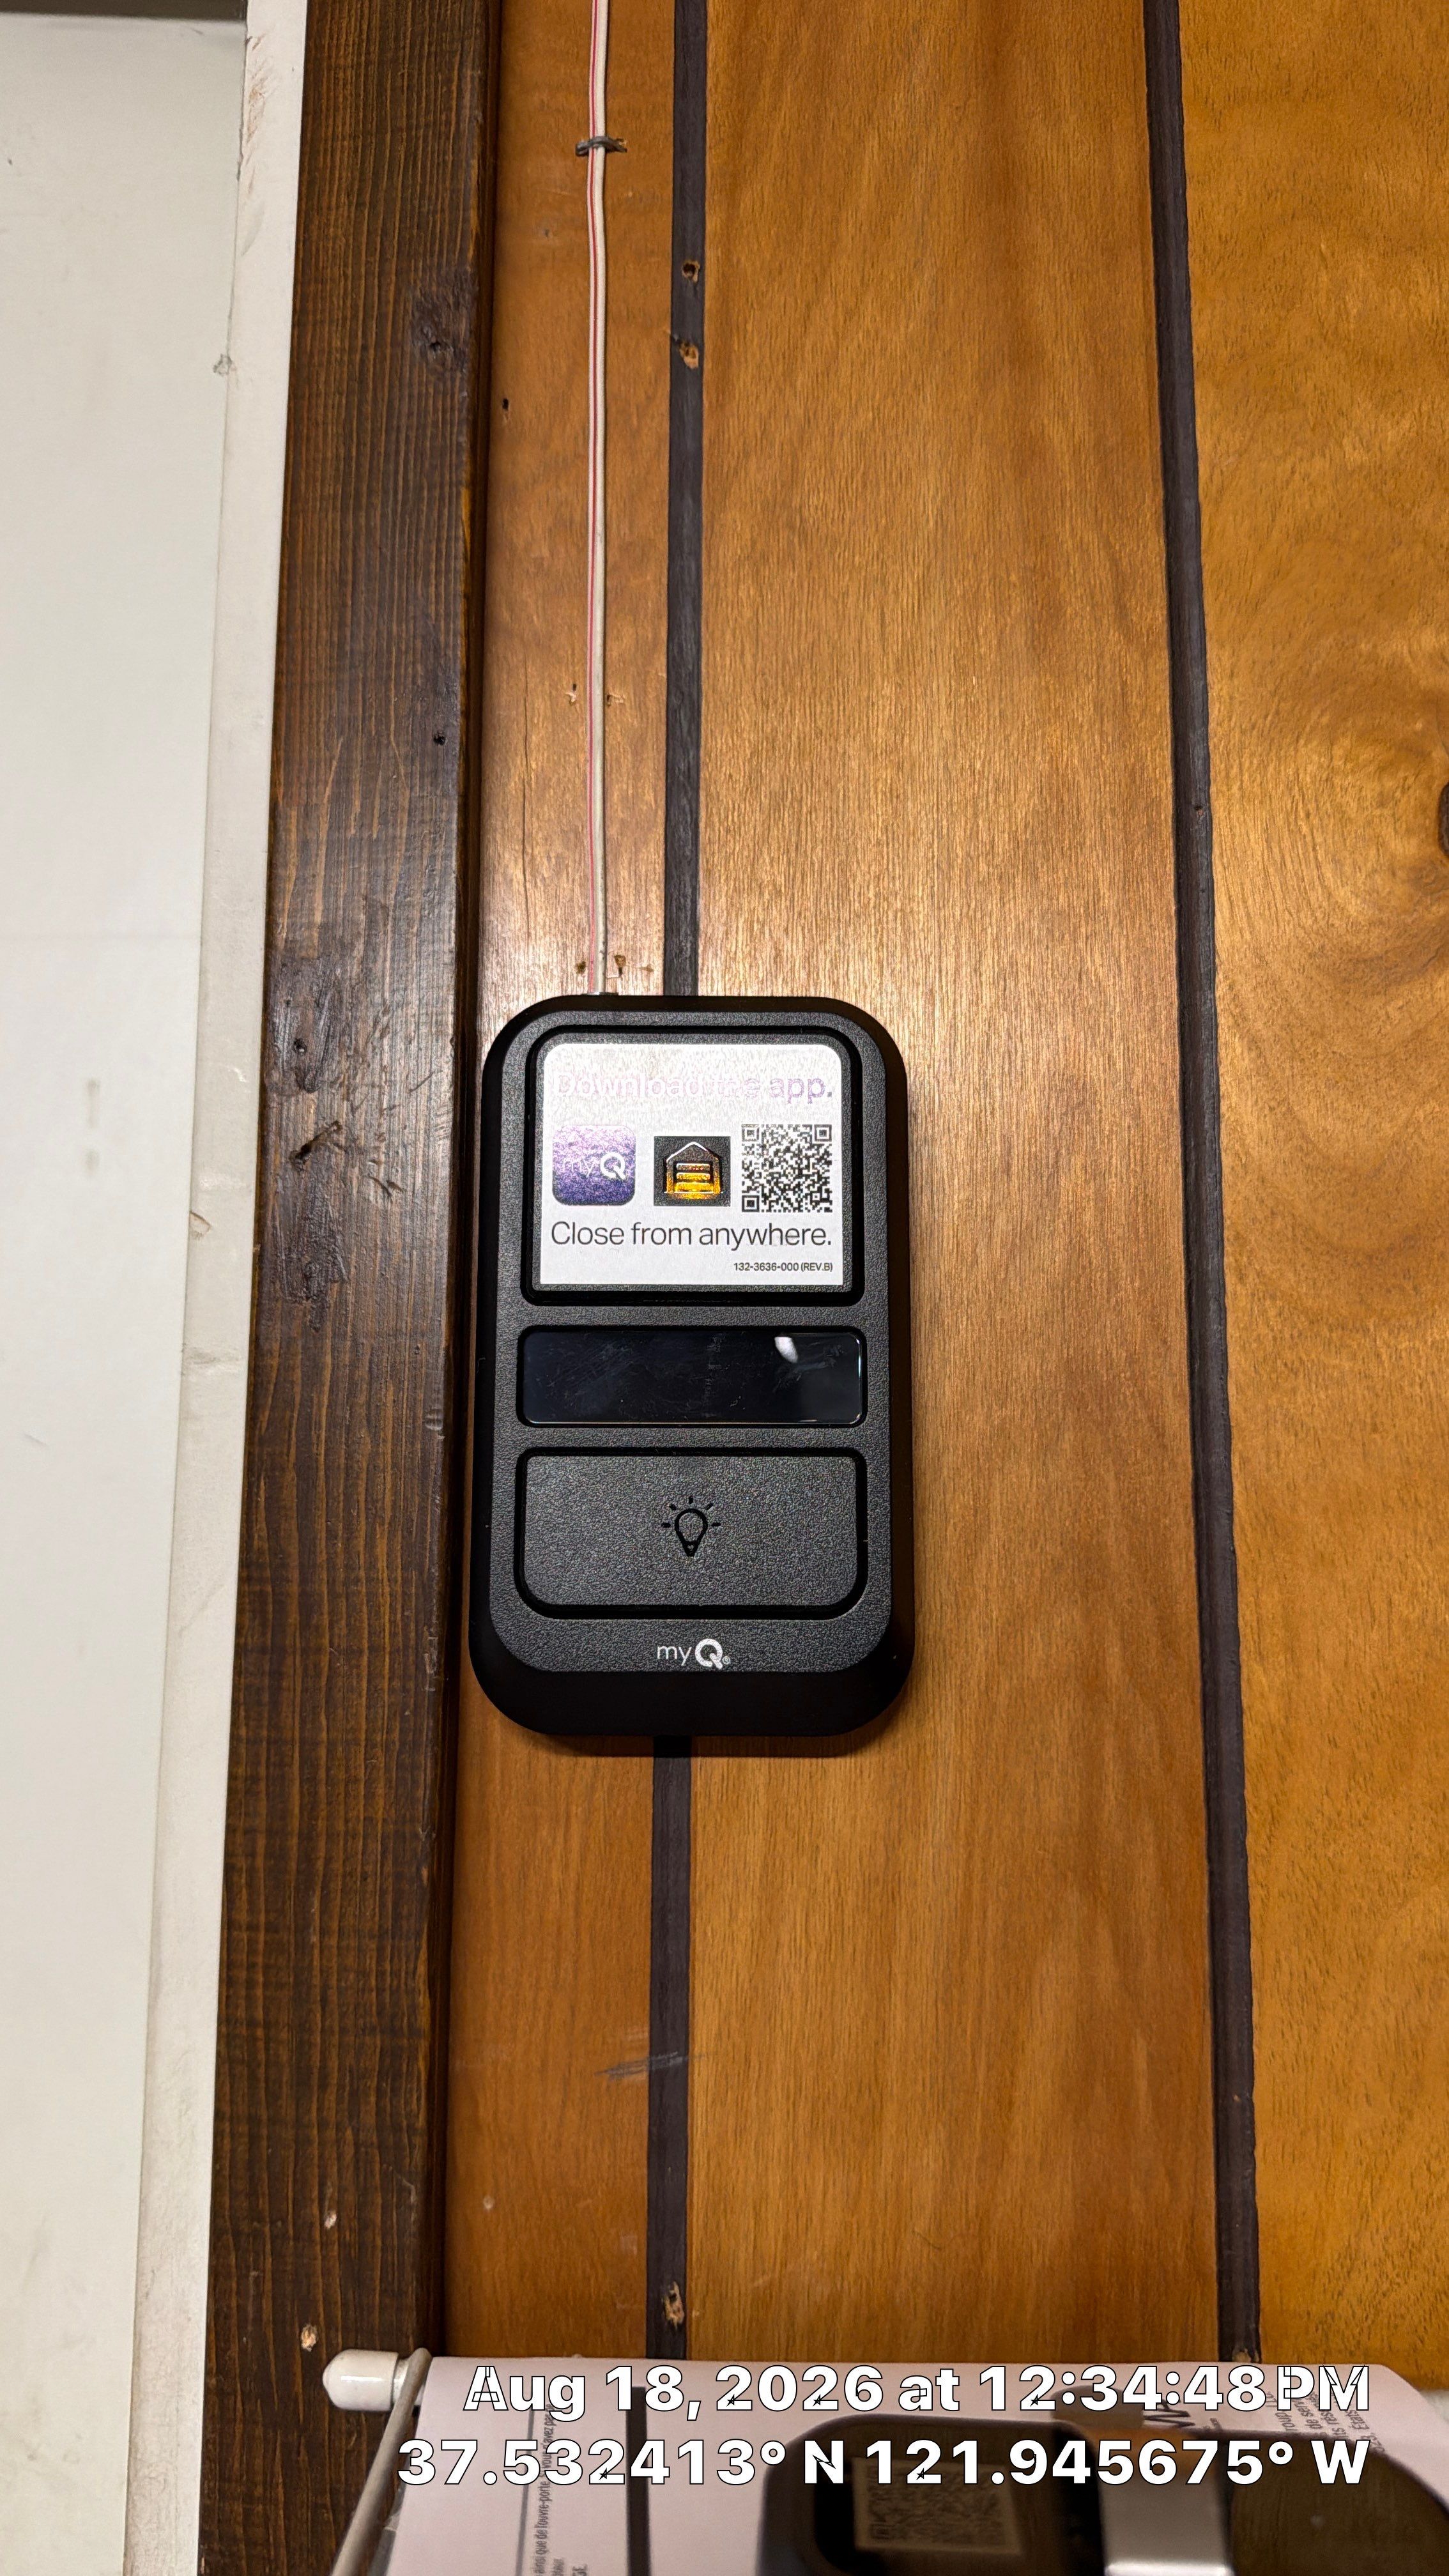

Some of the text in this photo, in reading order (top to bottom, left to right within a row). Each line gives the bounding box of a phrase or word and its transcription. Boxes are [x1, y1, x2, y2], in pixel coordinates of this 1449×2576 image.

[769, 1077, 832, 1104] app.
[562, 1151, 626, 1180] myQ
[551, 1220, 832, 1251] Close from anywhere.
[733, 1262, 833, 1272] 132-3636-000 (REV.B)
